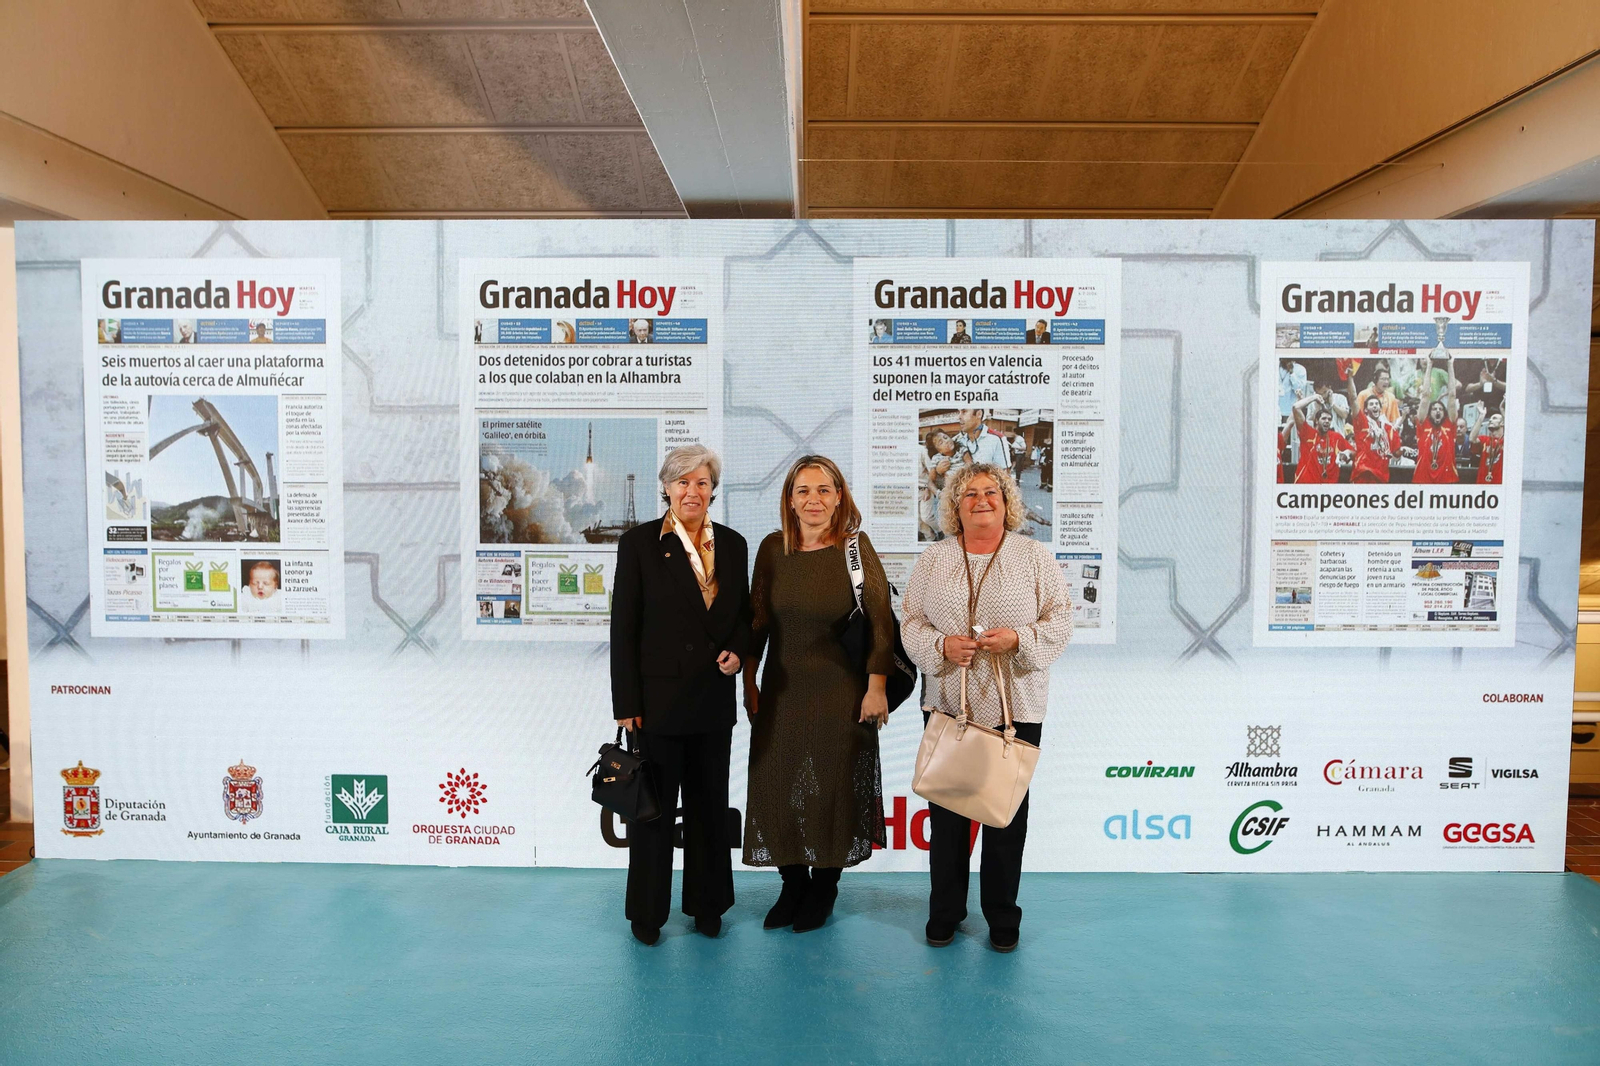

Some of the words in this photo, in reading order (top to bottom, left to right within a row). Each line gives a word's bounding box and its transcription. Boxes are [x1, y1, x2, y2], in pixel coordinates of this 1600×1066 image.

[102, 280, 230, 310] Granada
[236, 280, 295, 316] Hoy
[480, 279, 610, 308] Granada
[617, 280, 677, 316] Hoy
[874, 279, 1006, 309] Granada
[1014, 280, 1074, 316] Hoy
[1282, 283, 1414, 313] Granada
[1421, 284, 1482, 320] Hoy
[102, 355, 126, 368] Seis
[129, 356, 182, 368] muertos
[184, 354, 195, 368] al
[198, 358, 224, 368] caer
[227, 358, 251, 368] una
[254, 354, 324, 370] plataforma
[479, 354, 501, 366] Dos
[504, 354, 565, 366] detenidos
[568, 356, 590, 368] por
[592, 354, 633, 366] cobrar
[636, 357, 643, 366] a
[645, 354, 692, 366] turistas
[873, 356, 892, 366] Los
[896, 356, 910, 366] 41
[915, 356, 967, 367] muertos
[970, 358, 985, 366] en
[989, 355, 1042, 367] Valencia
[102, 374, 118, 387] de
[120, 374, 132, 387] la
[134, 372, 180, 387] autovía
[183, 376, 214, 387] cerca
[218, 374, 234, 387] de
[236, 372, 304, 387] Almuñécar
[479, 374, 486, 383] a
[489, 371, 506, 383] los
[510, 374, 532, 386] que
[536, 371, 584, 383] colaban
[587, 374, 602, 383] en
[606, 371, 617, 383] la
[620, 371, 681, 383] Alhambra
[873, 373, 927, 386] suponen
[931, 372, 942, 384] la
[945, 374, 985, 386] mayor
[988, 371, 1050, 384] catástrofe
[873, 389, 892, 401] del
[896, 390, 932, 401] Metro
[935, 392, 950, 401] en
[954, 388, 999, 404] España
[482, 421, 489, 429] El
[491, 421, 514, 431] primer
[516, 421, 542, 429] satélite
[525, 431, 546, 439] órbita
[1276, 492, 1389, 512] Campeones
[1394, 490, 1423, 508] del
[1430, 490, 1499, 508] mundo
[51, 685, 111, 694] PATROCINAN
[1482, 694, 1544, 703] COLABORAN
[1105, 760, 1195, 778] COVIRAN
[1224, 762, 1298, 779] Alhambra
[1324, 759, 1424, 785] Cámara
[1491, 769, 1539, 778] VIGILSA
[105, 798, 166, 811] Diputación
[105, 811, 117, 820] de
[120, 811, 166, 821] Granada
[326, 826, 350, 835] CAJA
[353, 826, 389, 835] RURAL
[412, 824, 471, 835] ORQUESTA
[473, 826, 515, 835] CIUDAD
[1103, 809, 1191, 840] alsa
[1242, 817, 1290, 836] CSIF
[1317, 825, 1422, 836] HAMMAM
[187, 831, 248, 840] Ayuntamiento
[263, 832, 301, 840] Granada
[428, 835, 442, 844] DE
[445, 836, 500, 845] GRANADA
